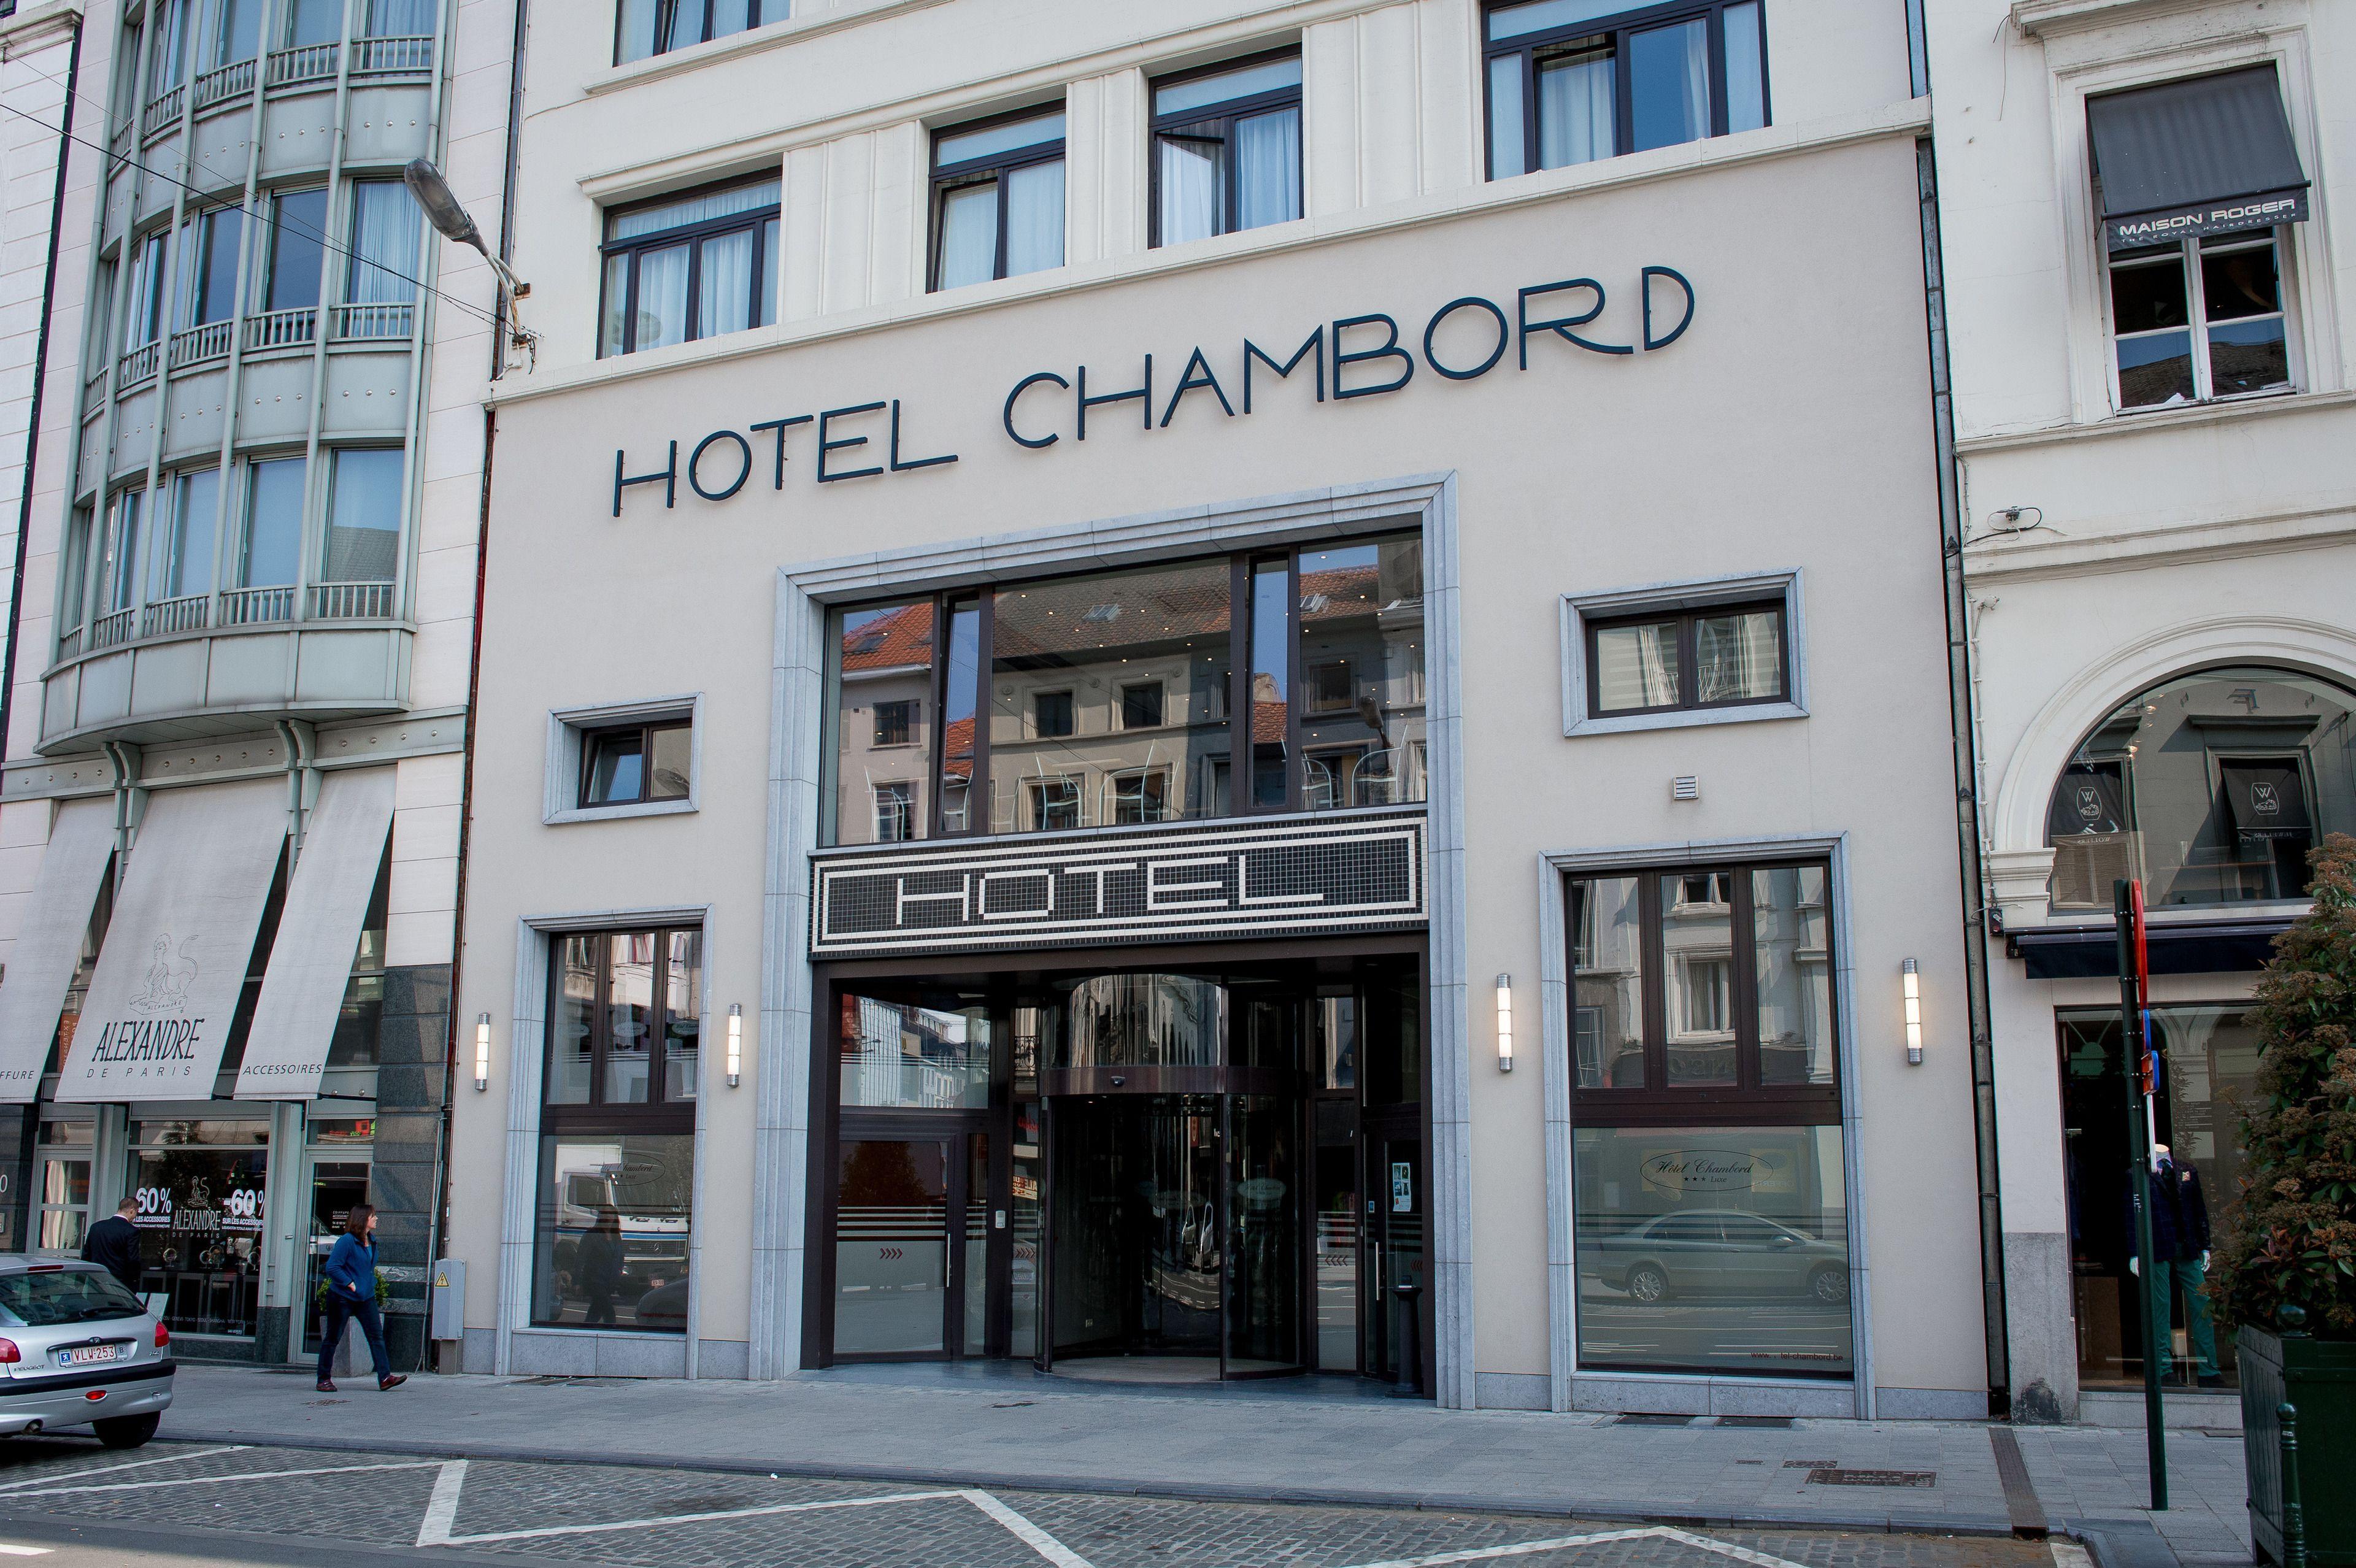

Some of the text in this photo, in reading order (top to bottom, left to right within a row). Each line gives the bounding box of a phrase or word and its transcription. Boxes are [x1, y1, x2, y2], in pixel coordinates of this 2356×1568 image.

[2119, 198, 2295, 236] MAISON ROGER
[2153, 229, 2195, 239] ROYAL
[2203, 213, 2296, 231] HAIRDRESSER
[614, 266, 1695, 517] HOTEL CHAMBORD
[896, 855, 1324, 925] HOTEL
[91, 1018, 205, 1063] ALEXANDRE
[0, 1070, 34, 1080] FFURE
[87, 1066, 191, 1078] DE PARIS
[242, 1064, 323, 1075] ACCESSOIRES
[1656, 1159, 1754, 1174] Hôtel Chambord
[172, 1209, 221, 1231] ALEXANDRE
[1750, 1351, 1843, 1361] www.tel-chambord.be
